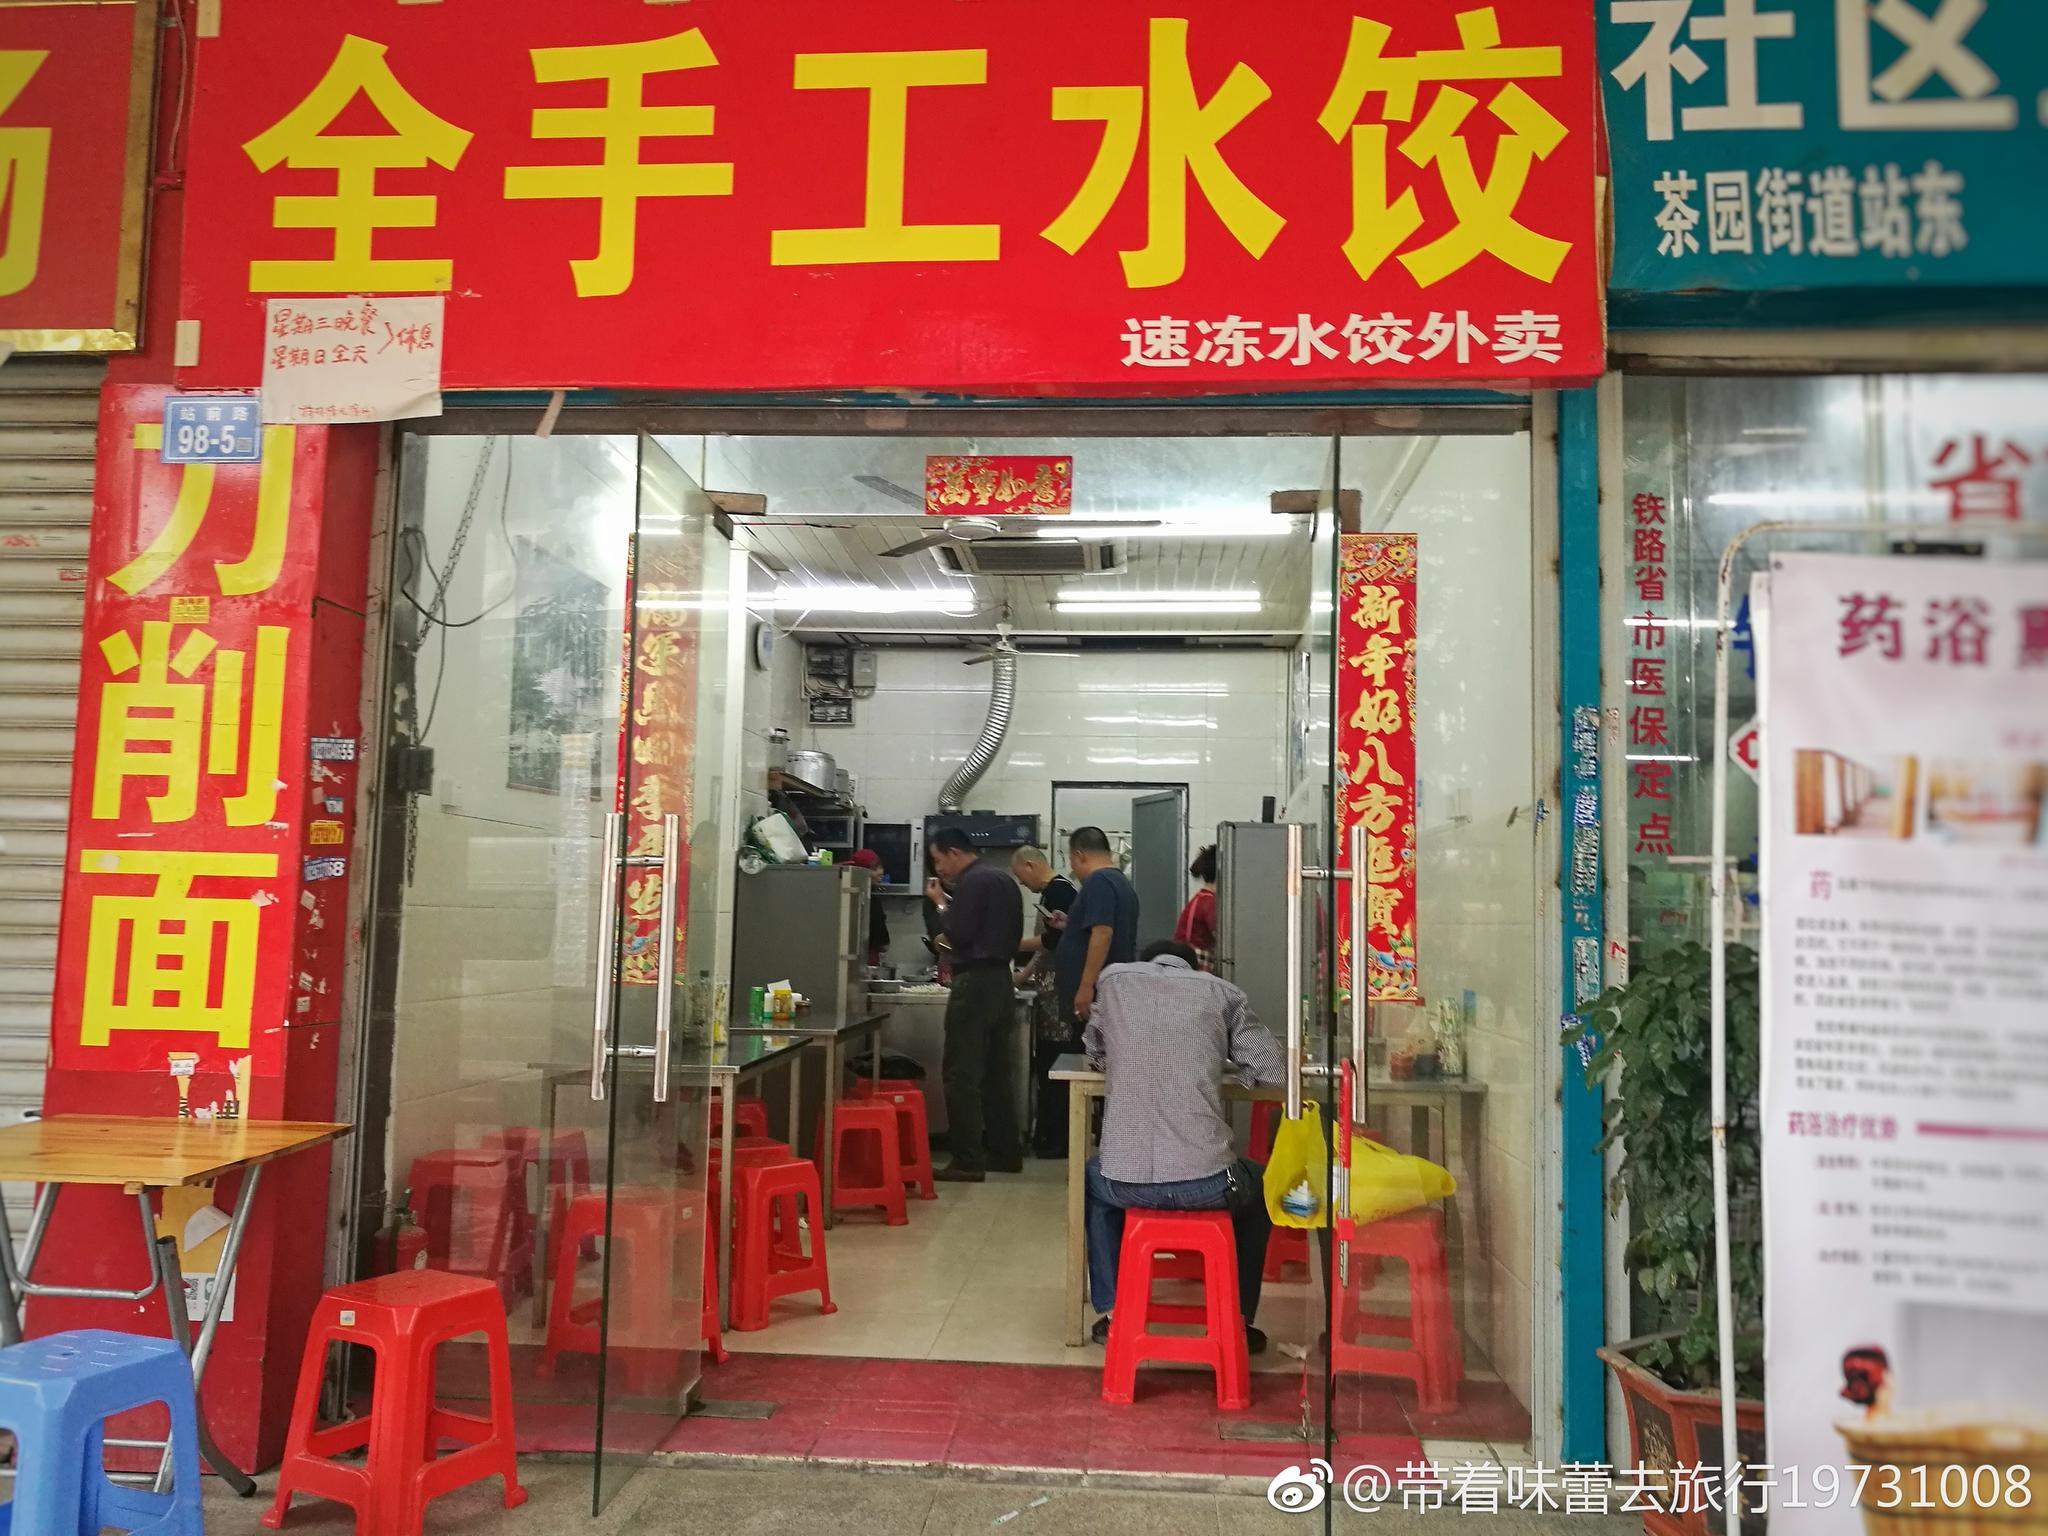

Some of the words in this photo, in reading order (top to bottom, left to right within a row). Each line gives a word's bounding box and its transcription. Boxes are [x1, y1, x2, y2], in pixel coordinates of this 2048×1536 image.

[1611, 0, 2048, 142] 社区
[242, 7, 1573, 297] 全手工水饺
[1653, 160, 1969, 259] 茶园街道站东
[271, 344, 368, 370] 星期日全天
[396, 322, 435, 353] 休息
[1120, 311, 1563, 368] 速冻水饺外卖
[1929, 433, 2048, 523] 省
[1630, 492, 1675, 855] 铁路省市医保定点
[80, 424, 297, 1049] 刀削面
